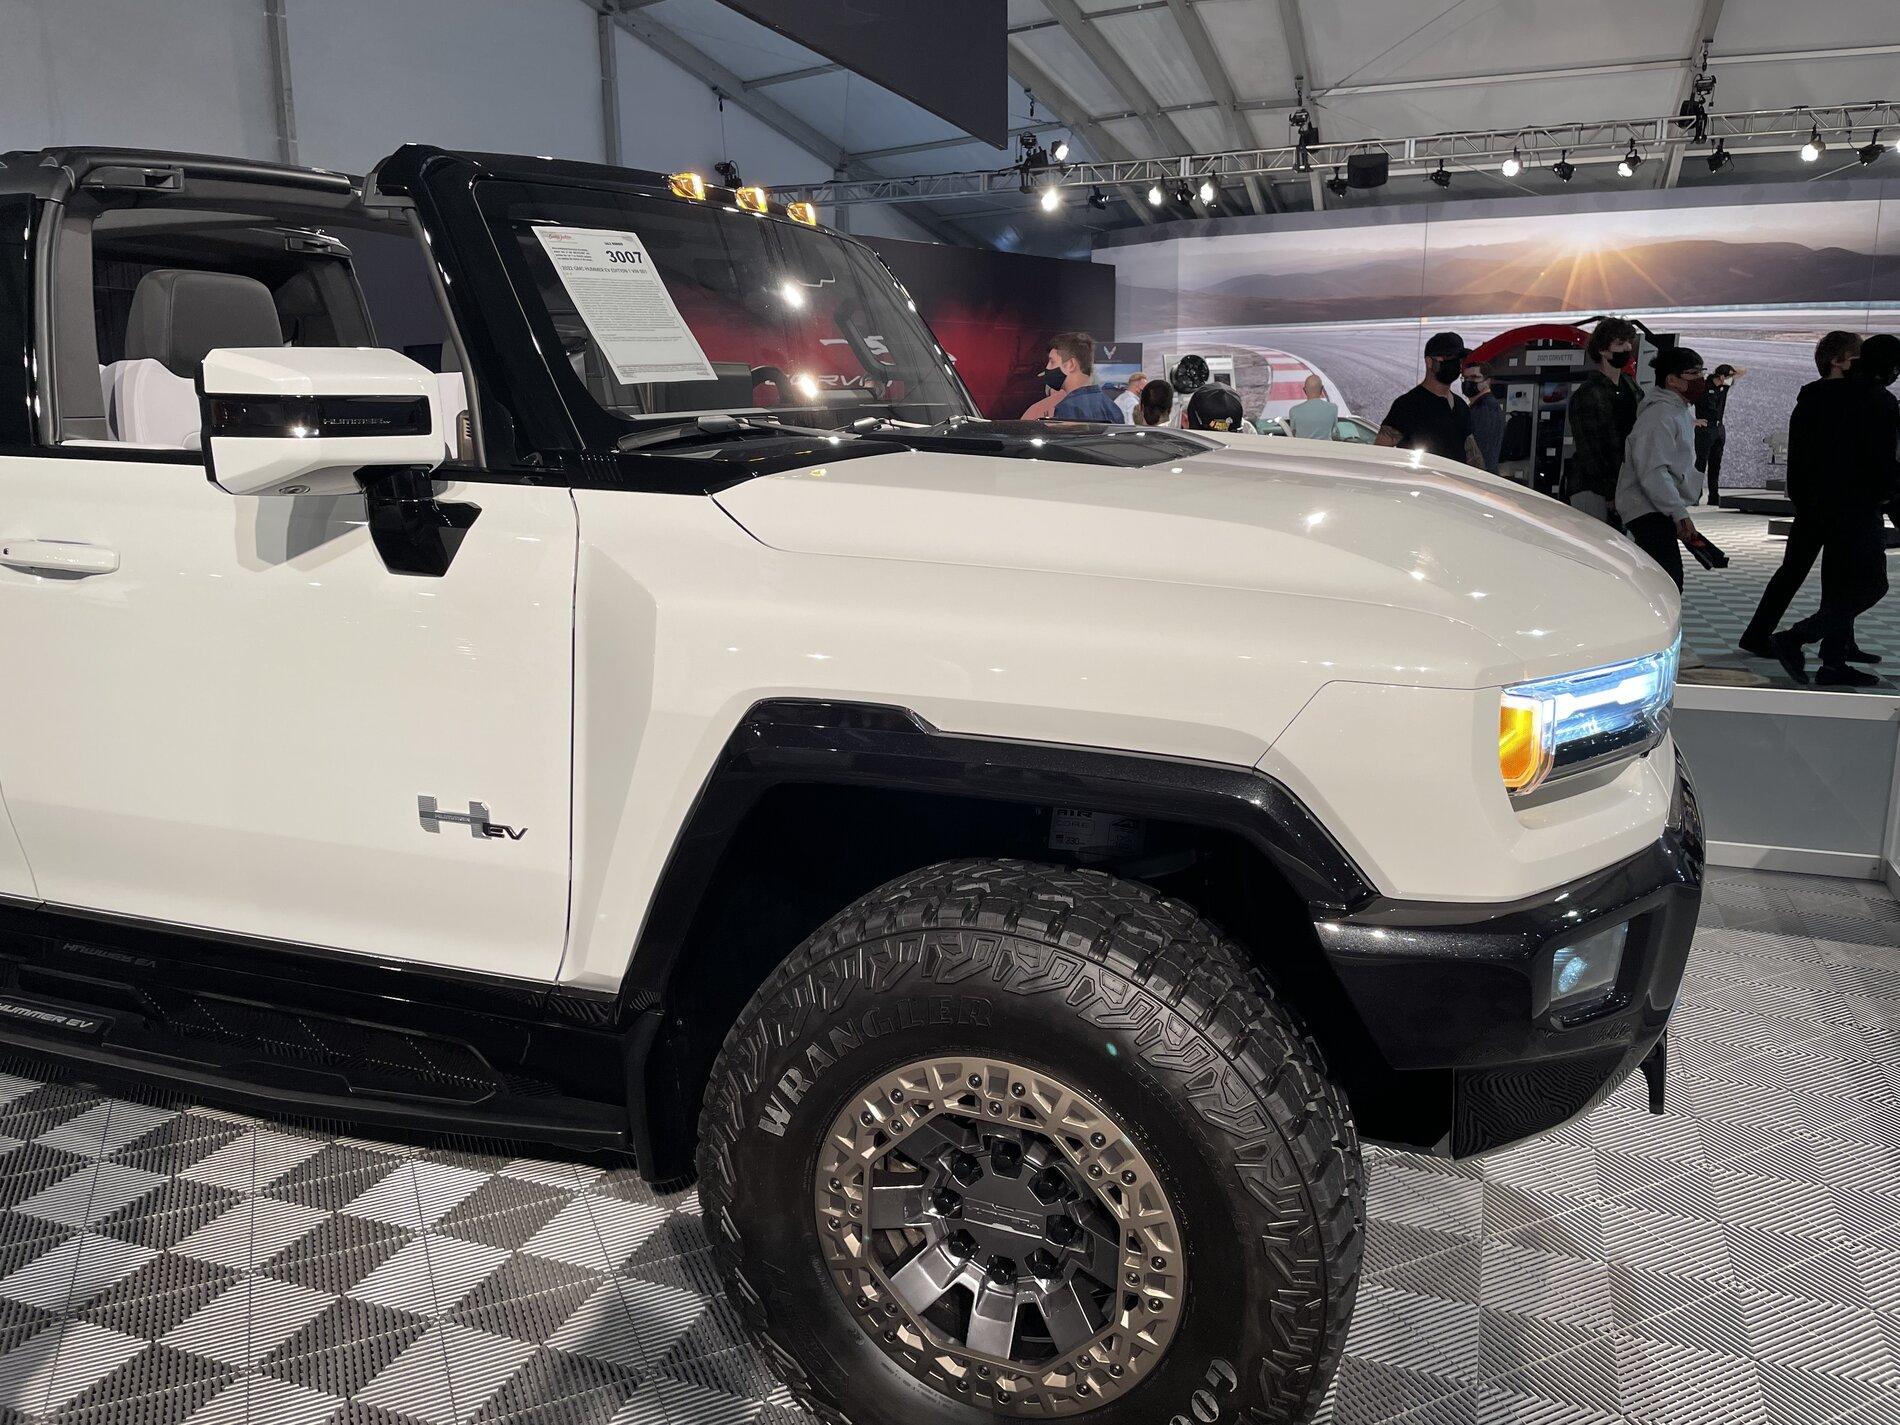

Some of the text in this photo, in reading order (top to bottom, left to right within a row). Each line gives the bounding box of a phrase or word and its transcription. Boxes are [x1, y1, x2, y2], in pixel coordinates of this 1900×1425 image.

[606, 250, 643, 264] 3007
[482, 822, 529, 840] EV
[66, 1018, 94, 1028] EV
[757, 995, 993, 1138] WRANGLER
